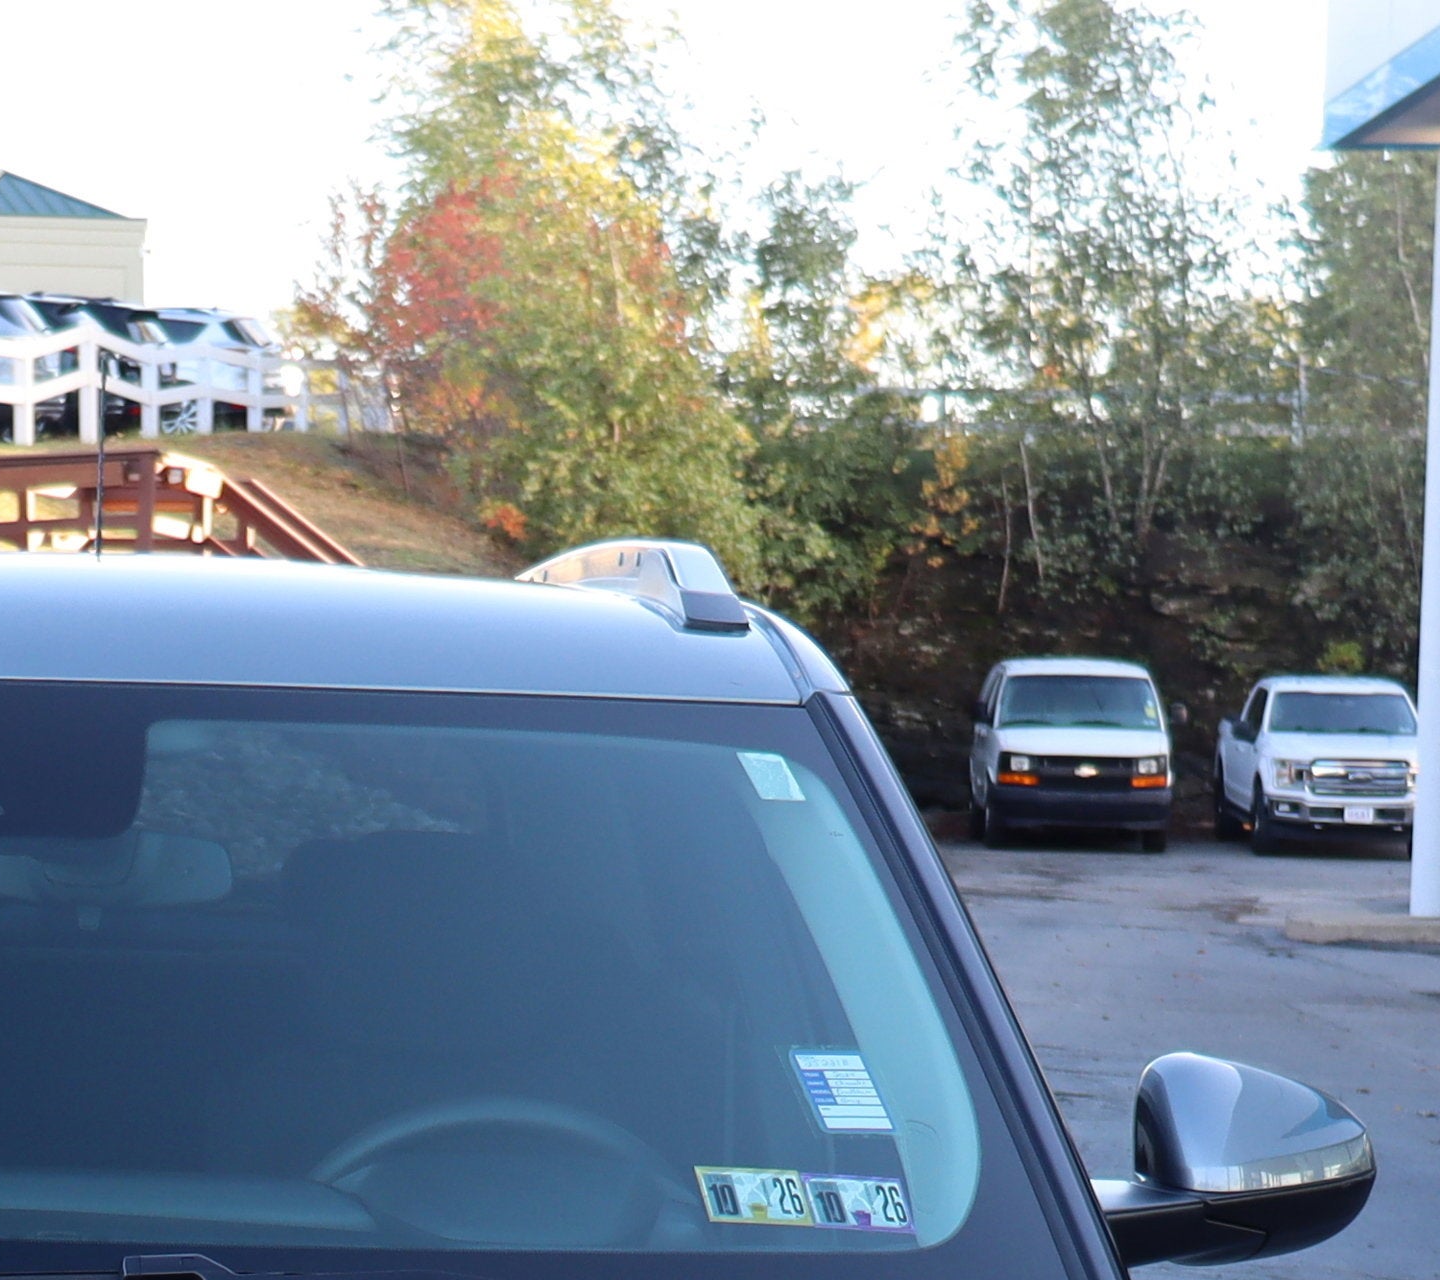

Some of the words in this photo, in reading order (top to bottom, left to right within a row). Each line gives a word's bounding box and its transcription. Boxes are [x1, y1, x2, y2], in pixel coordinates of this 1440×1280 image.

[709, 1183, 739, 1216] 10
[773, 1177, 805, 1216] 26
[815, 1191, 846, 1223] 10
[875, 1185, 908, 1223] 26
